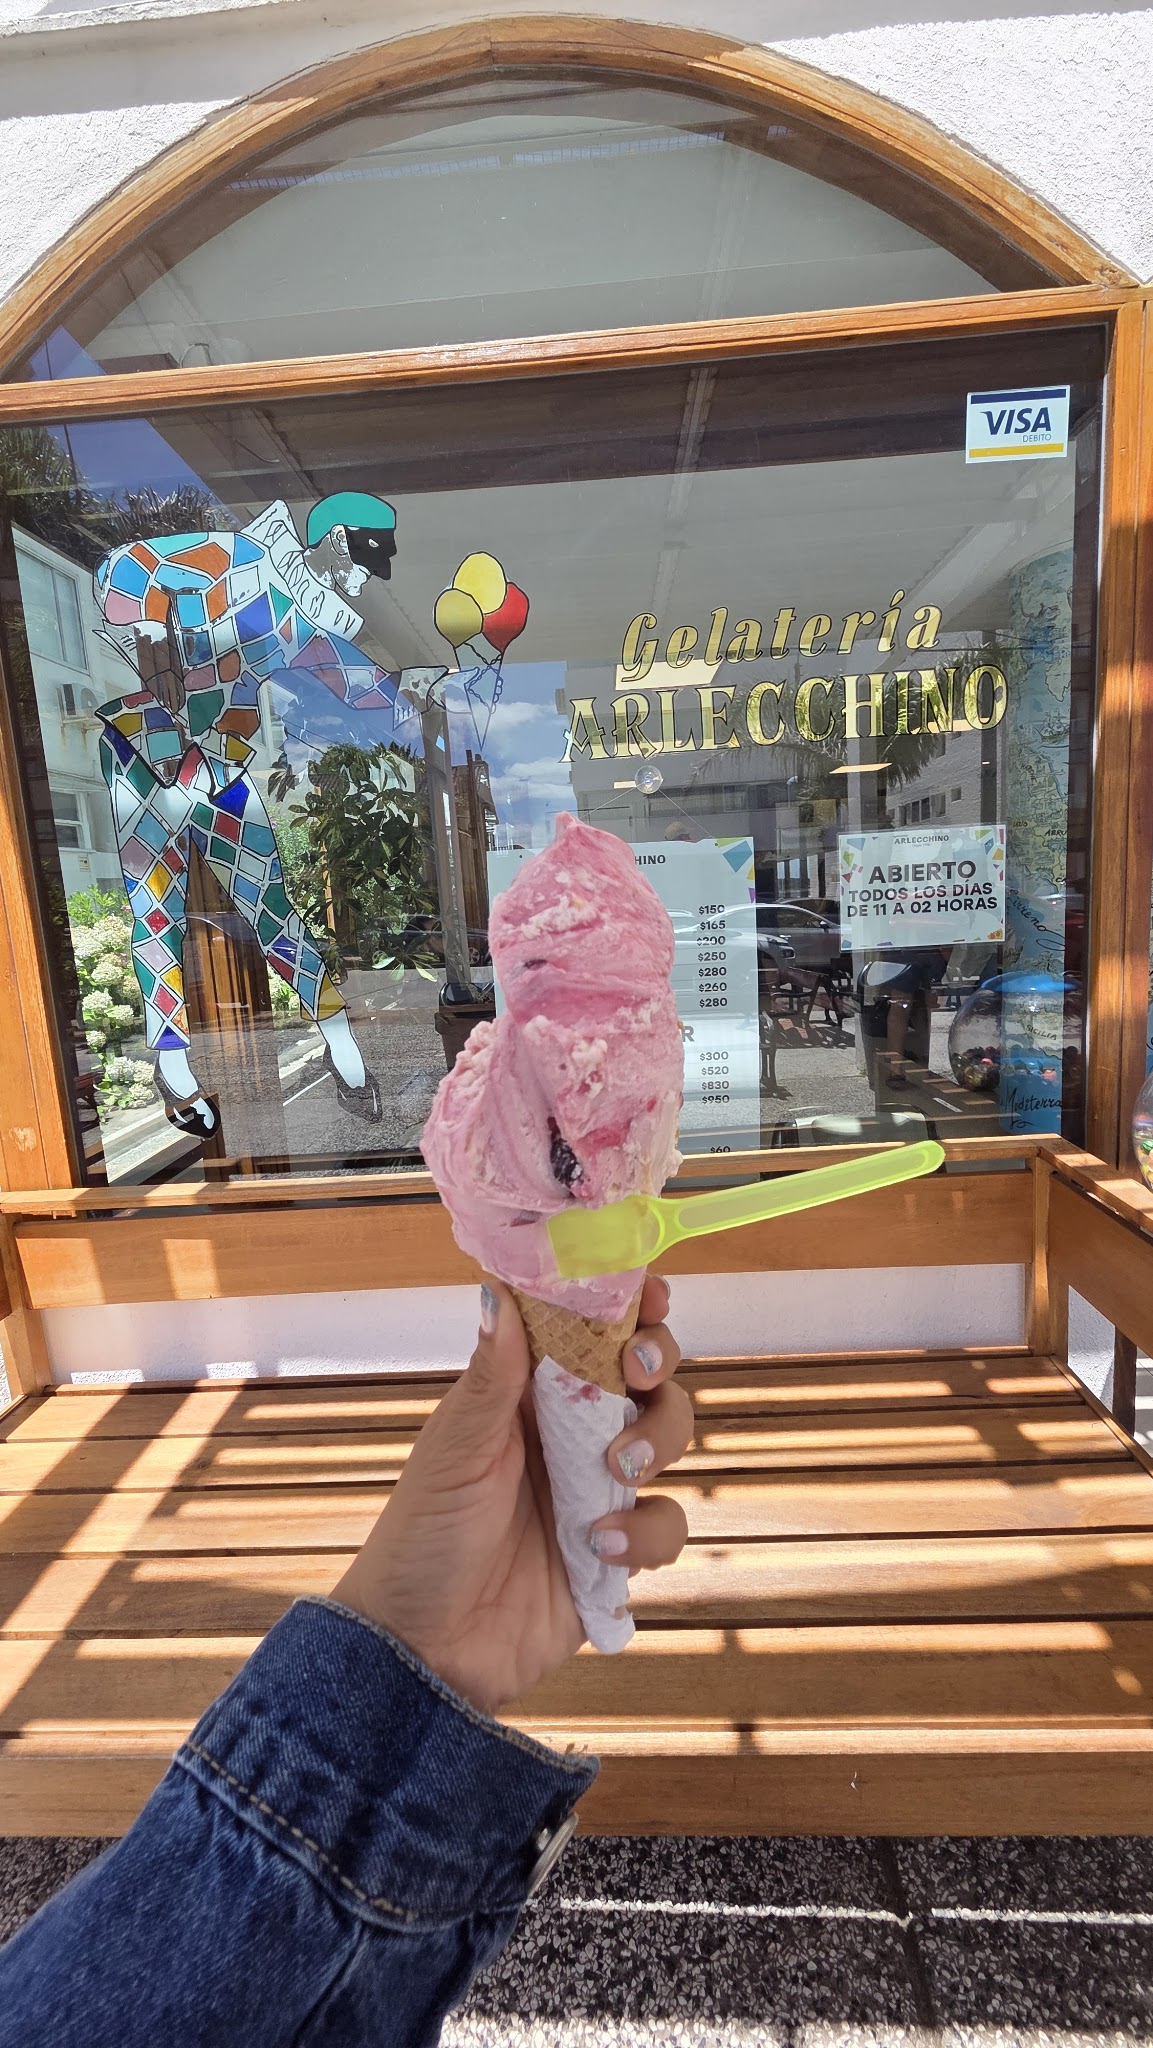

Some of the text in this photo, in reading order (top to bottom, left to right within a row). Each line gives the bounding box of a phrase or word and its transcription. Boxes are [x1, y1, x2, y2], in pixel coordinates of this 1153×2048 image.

[980, 407, 1052, 436] VISA
[1022, 433, 1052, 443] DEBITO
[620, 588, 943, 682] Gelatería
[558, 664, 1009, 763] ARLECCHINO
[893, 834, 950, 845] ARLECCHINO
[868, 860, 977, 885] ABIERTO
[848, 879, 993, 903] TODOS LOS DÍAS
[698, 904, 725, 915] $150
[847, 896, 998, 918] DE 11 A 02 HORAS
[699, 920, 726, 930] $165
[697, 936, 726, 946] $200
[697, 951, 727, 962] $250
[698, 966, 727, 977] $280
[698, 982, 728, 992] $260
[699, 997, 728, 1008] $280
[1025, 1024, 1057, 1041] SICILIA
[699, 1051, 729, 1061] $300
[701, 1066, 729, 1075] $520
[701, 1080, 730, 1090] $830
[701, 1095, 730, 1104] $950
